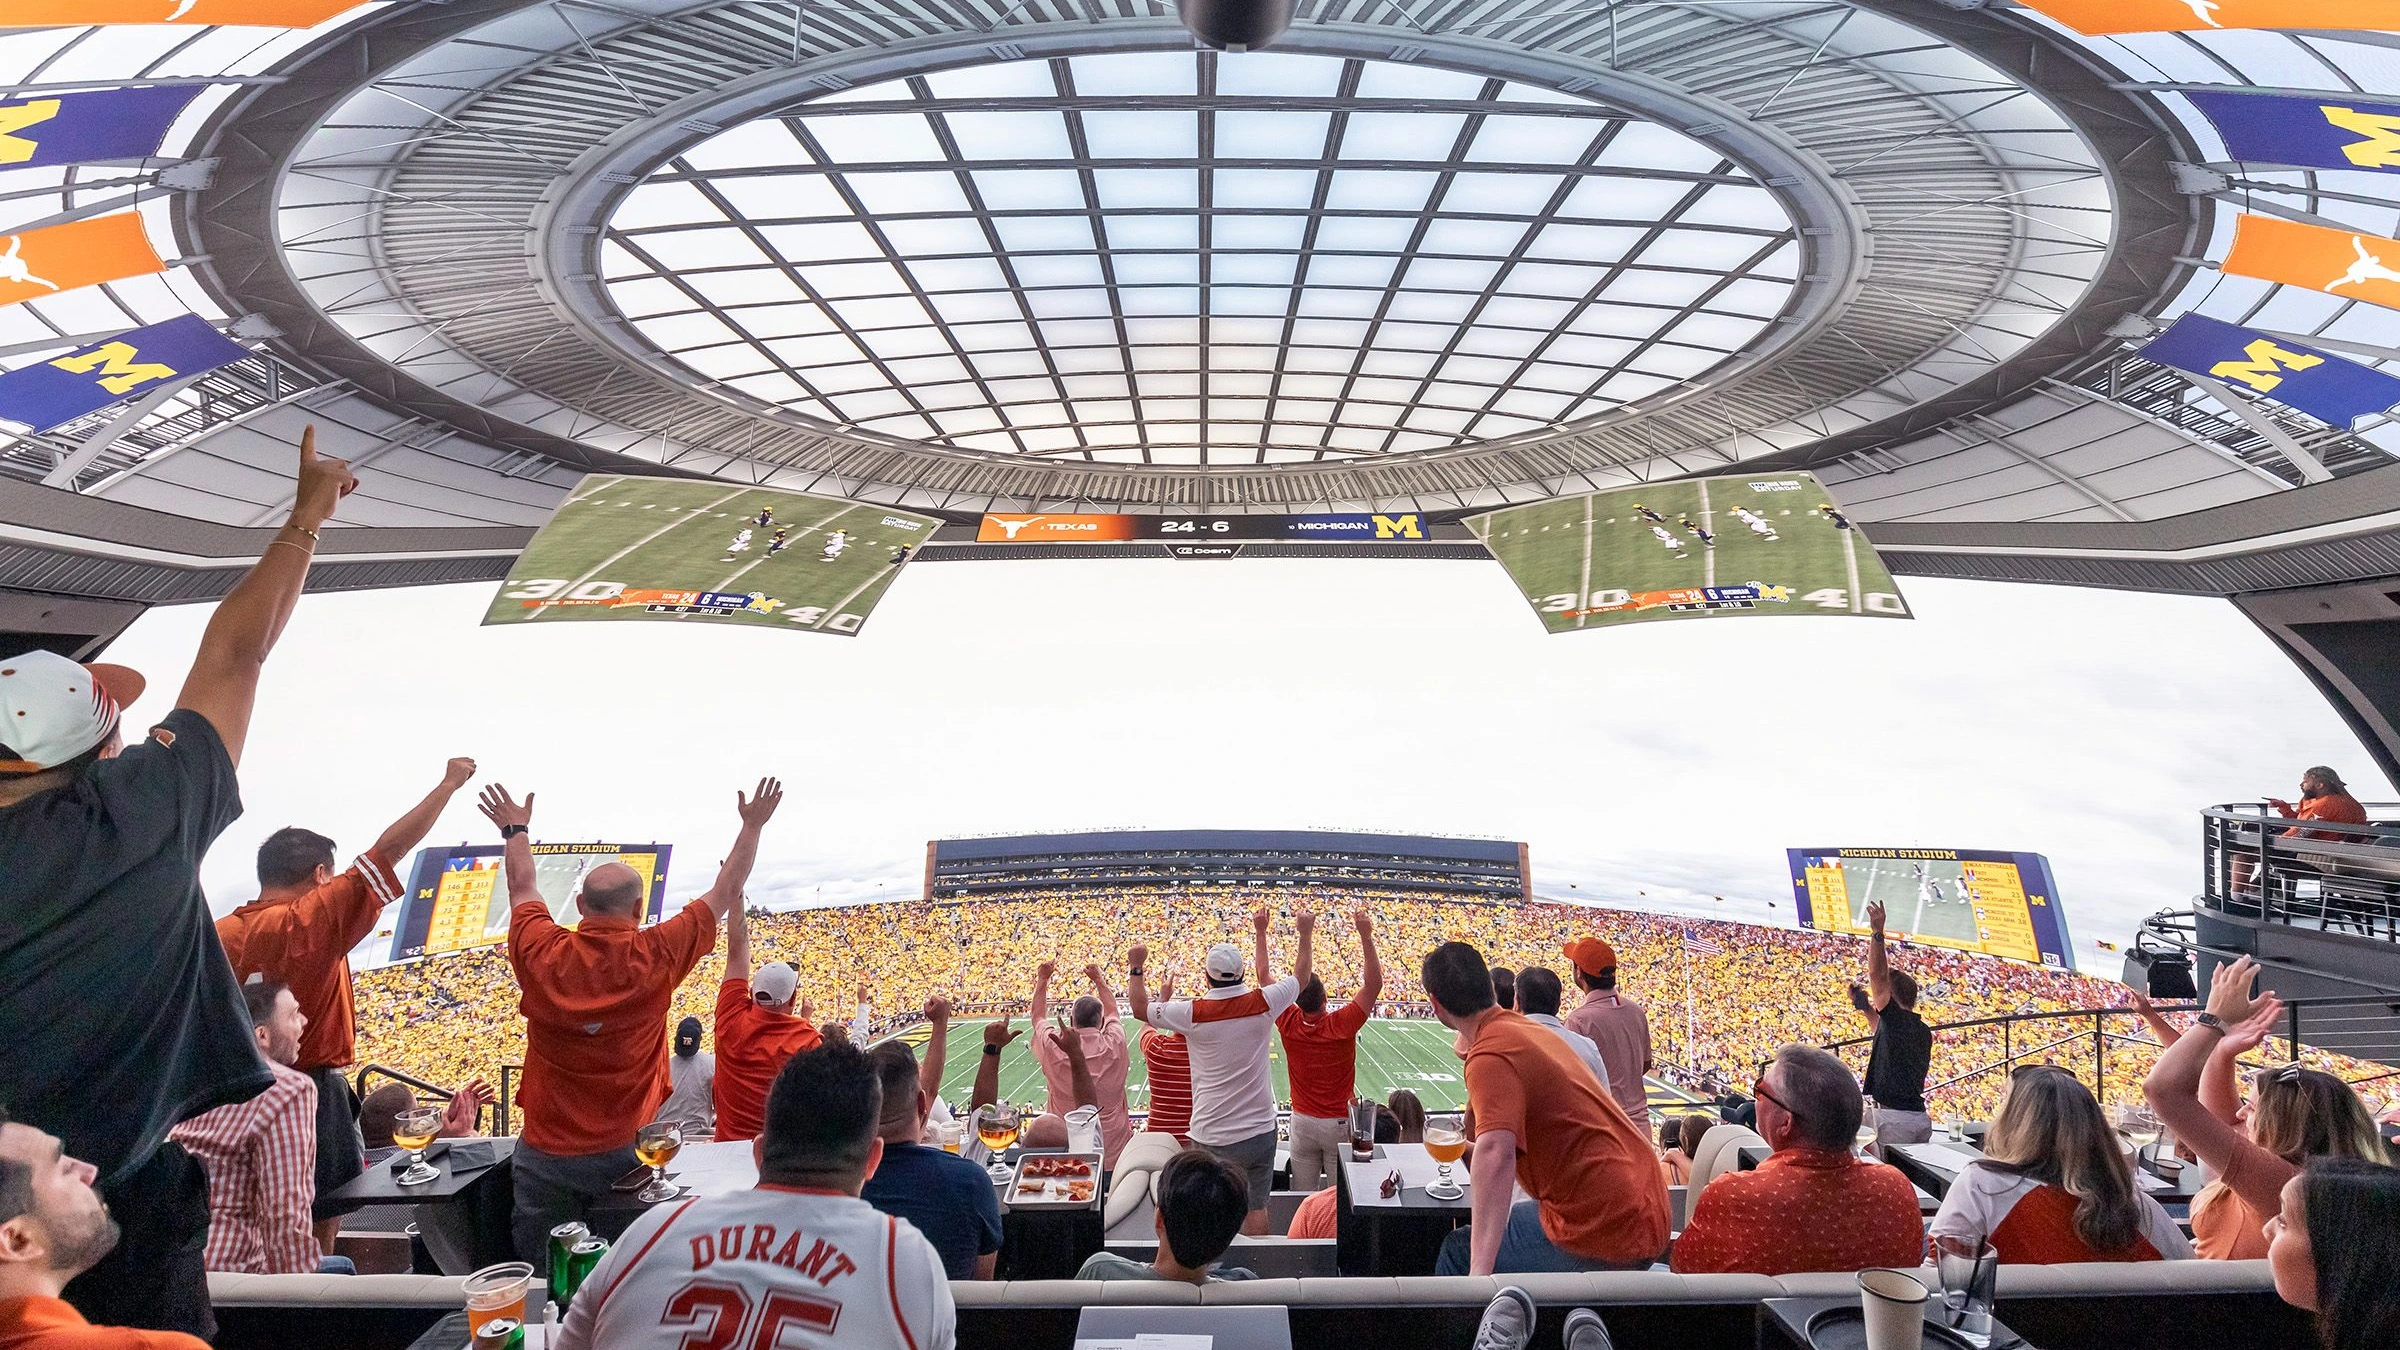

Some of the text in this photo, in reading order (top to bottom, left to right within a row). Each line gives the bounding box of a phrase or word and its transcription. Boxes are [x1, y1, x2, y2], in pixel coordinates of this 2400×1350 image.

[48, 341, 178, 395] M
[2209, 339, 2326, 394] M
[1047, 523, 1098, 531] TEXAS
[1160, 521, 1196, 533] 24
[1212, 521, 1230, 533] 6
[1298, 522, 1369, 530] MICHIGAN
[681, 592, 697, 605] 24
[701, 593, 713, 604] 6
[1686, 590, 1704, 601] 24
[1707, 588, 1719, 600] 6
[570, 844, 621, 853] STADIUM
[1839, 849, 1958, 859] MICHIGAN STADIUM
[419, 888, 434, 899] M
[2029, 894, 2047, 907] M
[689, 1224, 858, 1288] DURANT
